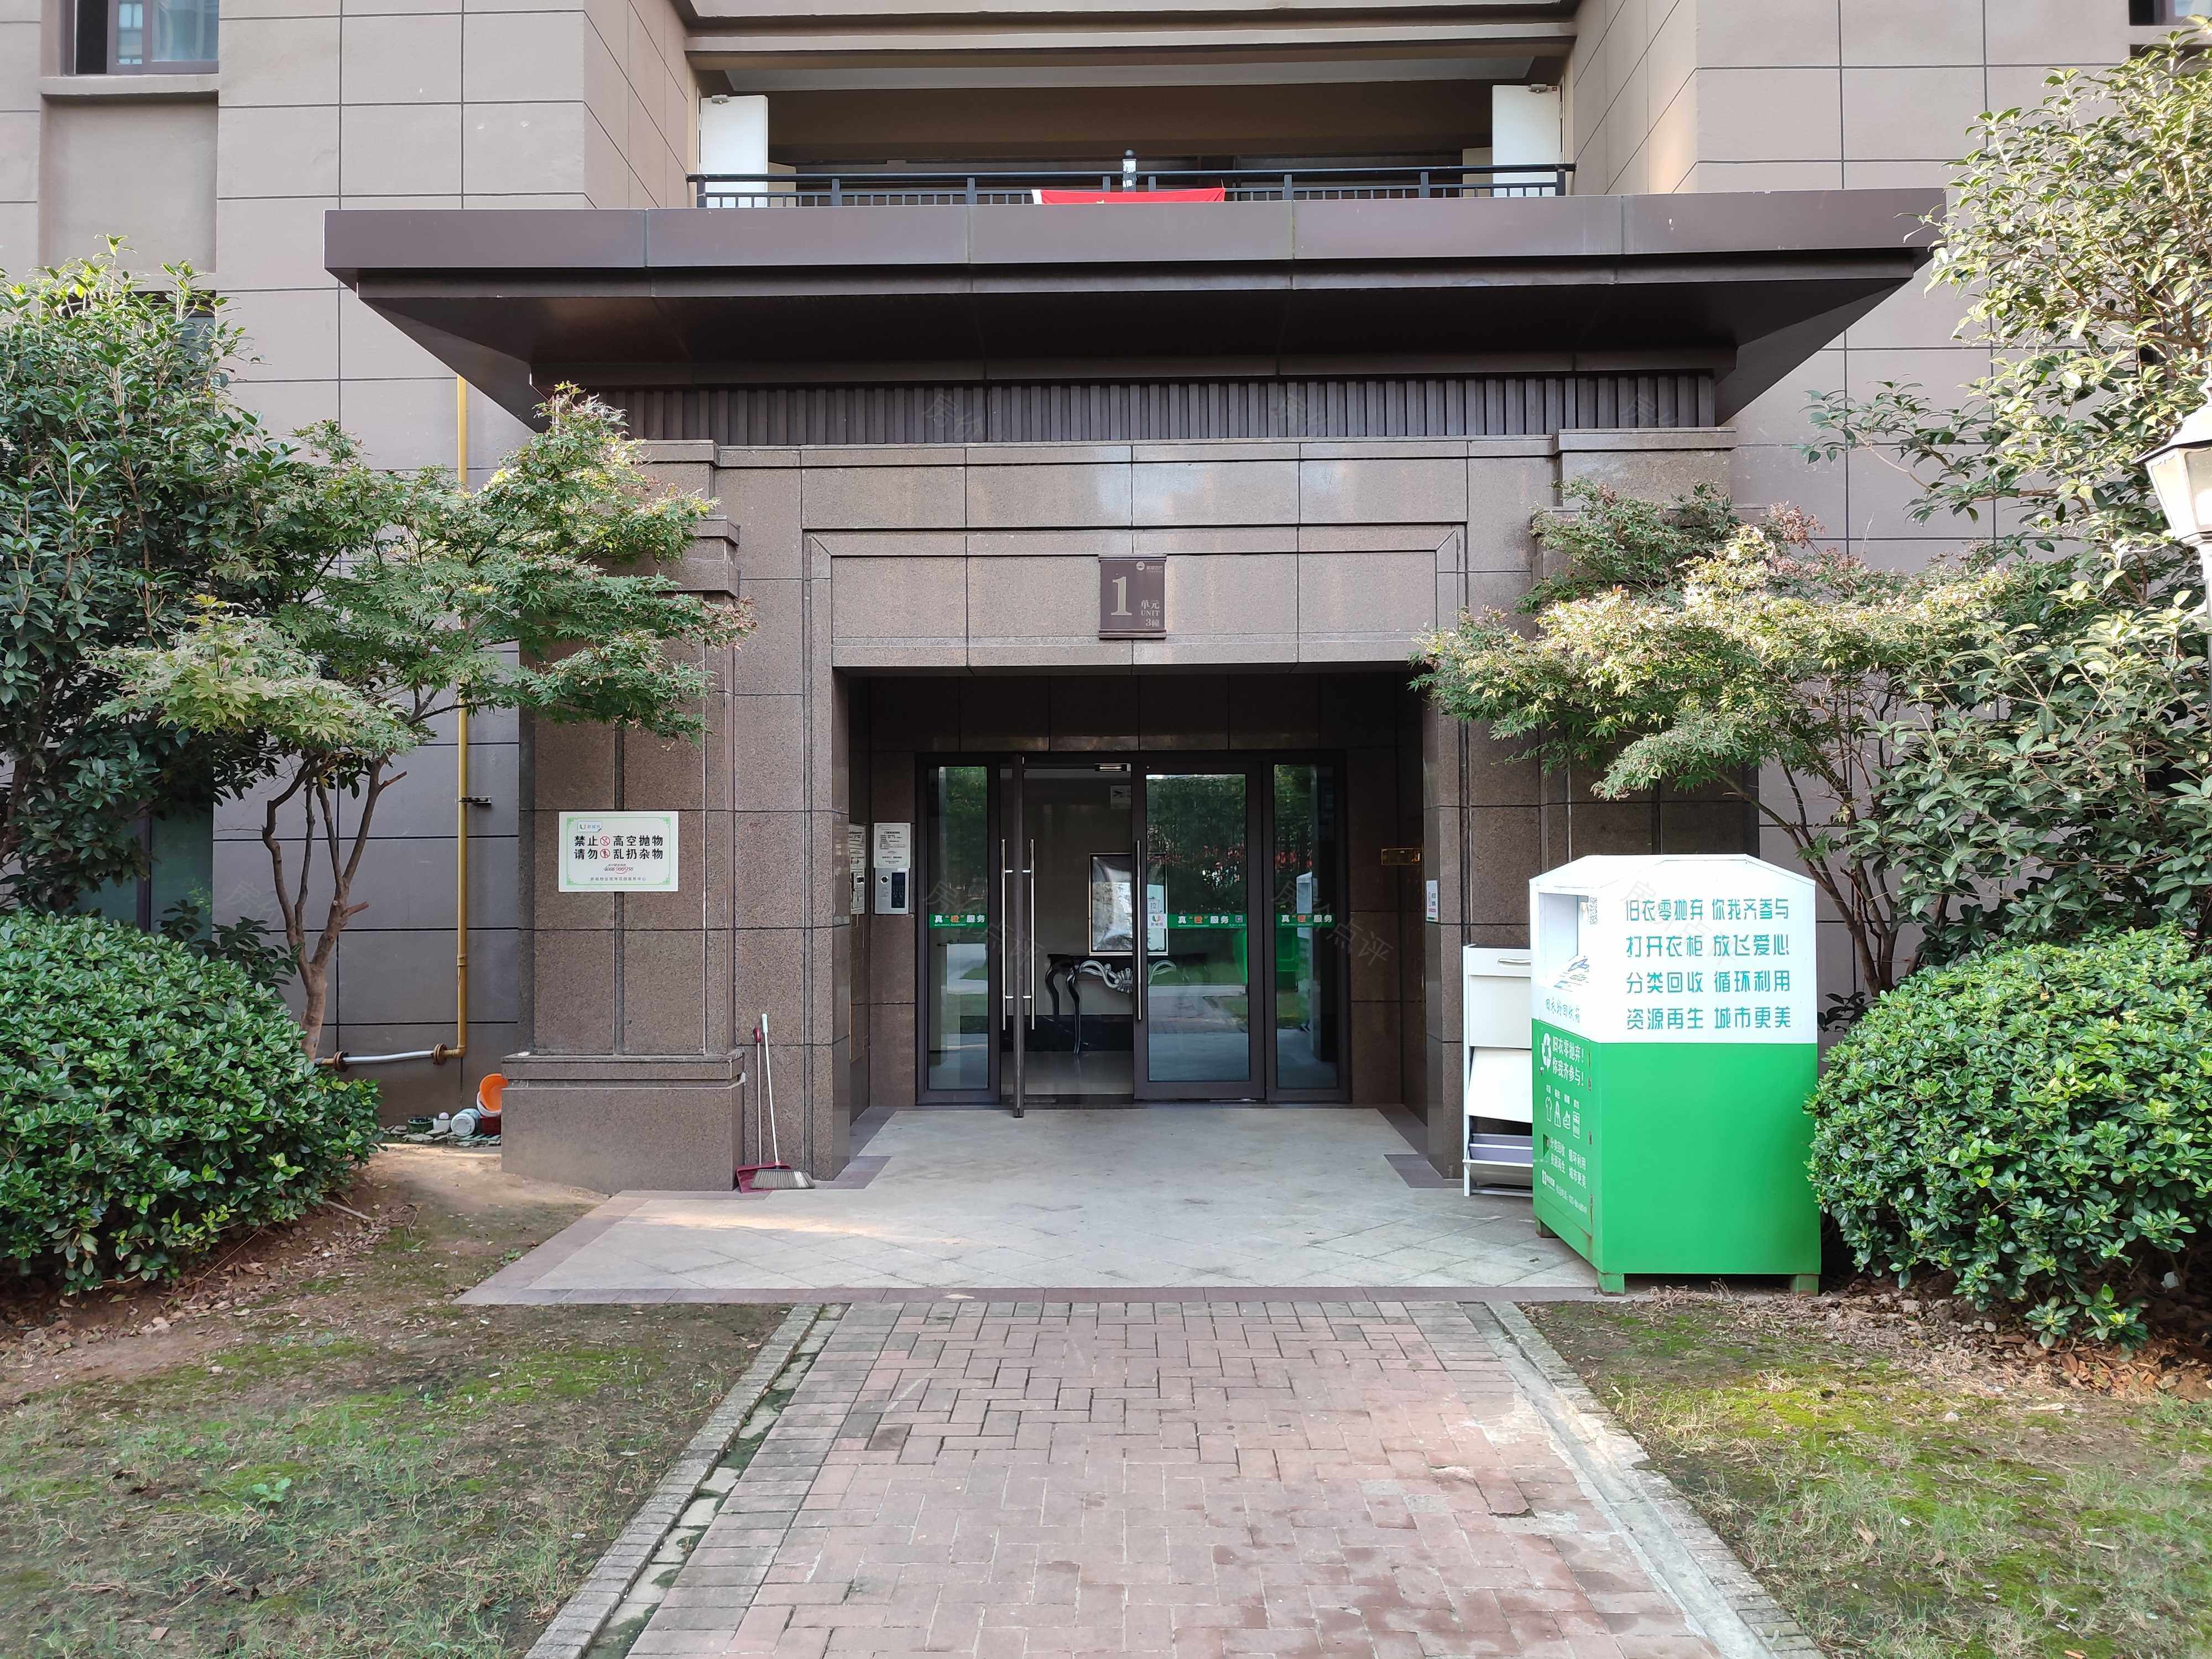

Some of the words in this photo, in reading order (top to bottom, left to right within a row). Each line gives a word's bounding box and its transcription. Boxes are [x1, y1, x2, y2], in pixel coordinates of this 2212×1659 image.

[1111, 576, 1132, 615] 1
[1141, 599, 1160, 609] 单元
[1145, 618, 1160, 627] 3幢
[575, 835, 599, 847] 禁止
[613, 835, 663, 847] 高空抛物
[574, 848, 598, 860] 请勿
[613, 848, 663, 860] 乱扔杂物
[1626, 899, 1703, 921] 旧衣零抛弃
[1712, 898, 1789, 921] 你我齐参与
[1626, 936, 1703, 958] 打开衣柜
[1713, 933, 1789, 957] 放飞爱心
[1626, 972, 1704, 994] 分类回收
[1714, 971, 1791, 993] 循环利用
[1626, 1008, 1704, 1030] 资源再生
[1714, 1006, 1792, 1030] 城市更美
